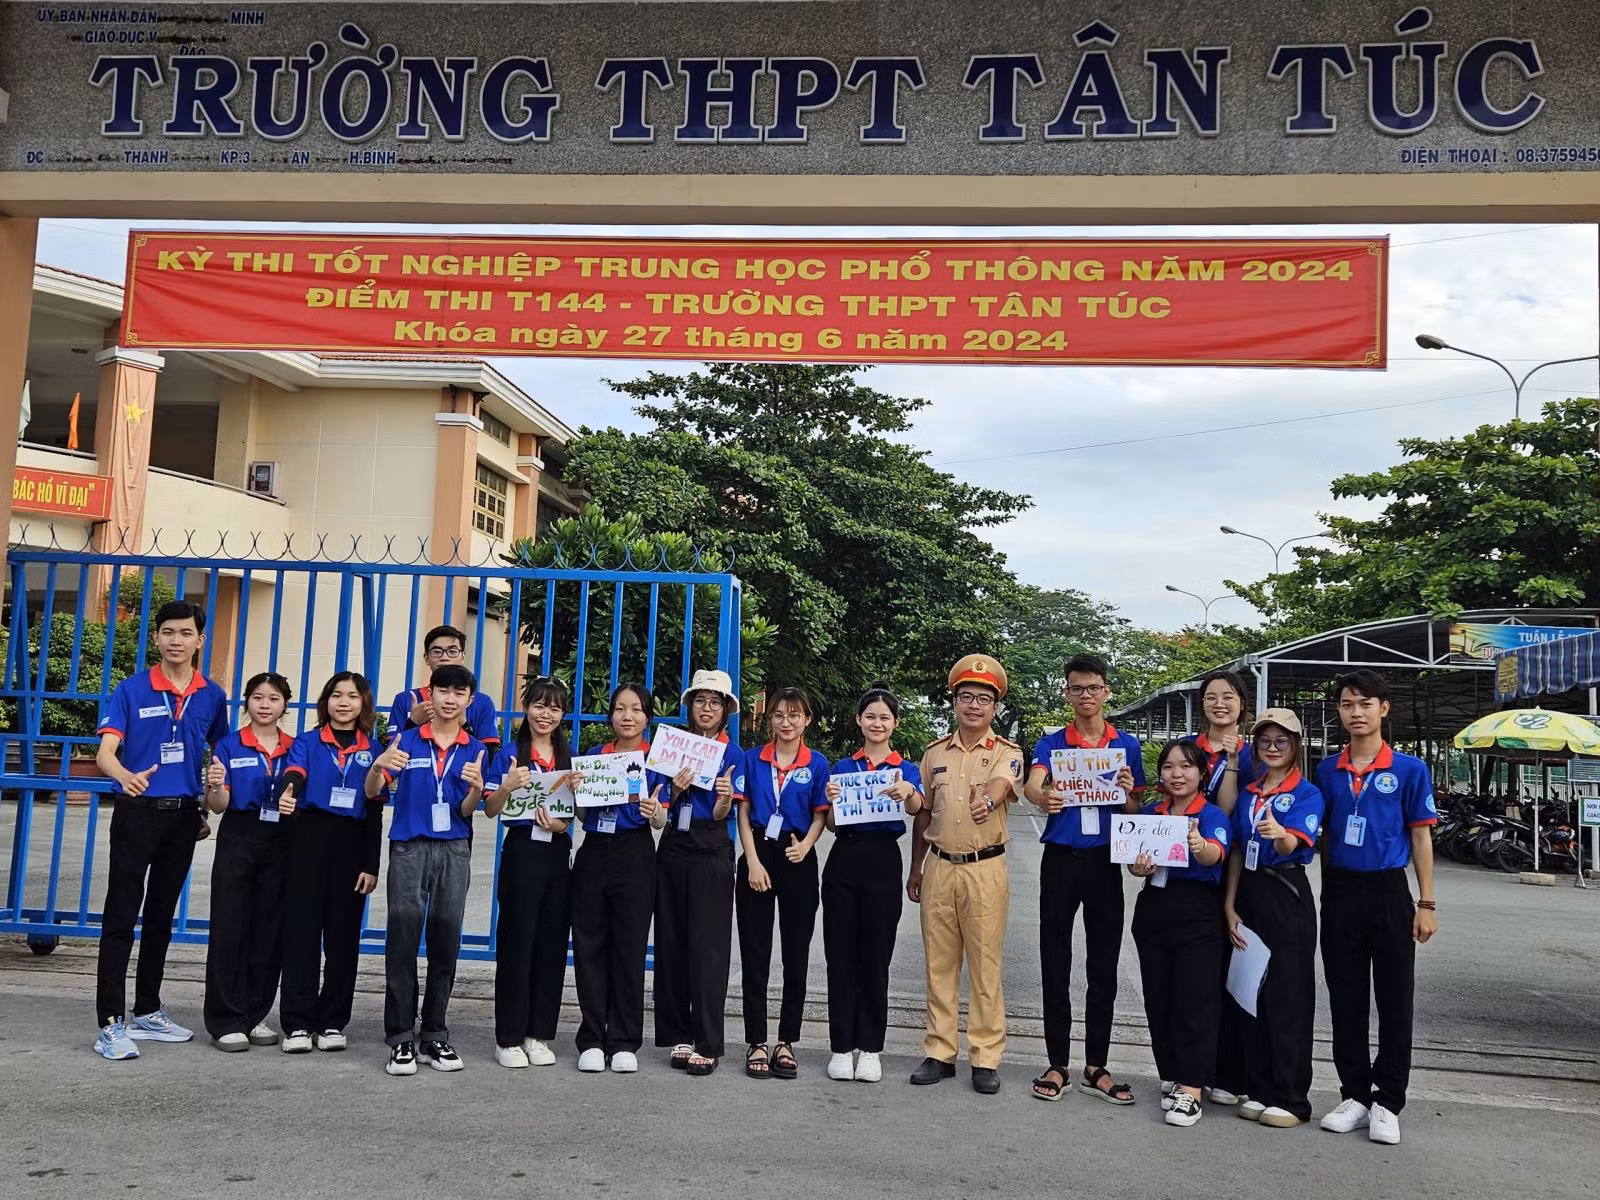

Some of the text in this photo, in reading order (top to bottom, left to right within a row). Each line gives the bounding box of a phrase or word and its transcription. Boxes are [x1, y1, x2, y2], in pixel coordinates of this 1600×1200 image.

[59, 9, 85, 22] BAN
[230, 12, 264, 25] MINH
[119, 30, 145, 47] DỤC
[89, 6, 1545, 144] TRƯỜNG THPT TÂN TÚC
[124, 150, 168, 164] THANH
[349, 148, 396, 164] H.BÌNH
[1401, 146, 1439, 167] ĐIỆN
[1448, 149, 1498, 167] THOẠI
[158, 246, 1353, 286] KỲ THI TỐT NGHIỆP TRUNG HỌC PHỔ THÔNG NĂM 2024
[306, 279, 409, 308] ĐIỂM
[424, 290, 493, 311] THI
[508, 292, 606, 312] T144
[646, 289, 824, 316] TRƯỜNG
[840, 296, 956, 317] THPT
[971, 292, 1061, 317] TÂN
[1078, 292, 1170, 318] TÚC
[395, 321, 1067, 352] Khóa ngày 27 tháng 6 năm 2024
[13, 476, 34, 500] BÁC
[37, 477, 53, 502] HỒ
[56, 481, 67, 504] VĨ
[1514, 714, 1552, 729] C2
[659, 748, 677, 765] DO
[663, 732, 719, 760] YOU CAN
[549, 799, 573, 813] nha
